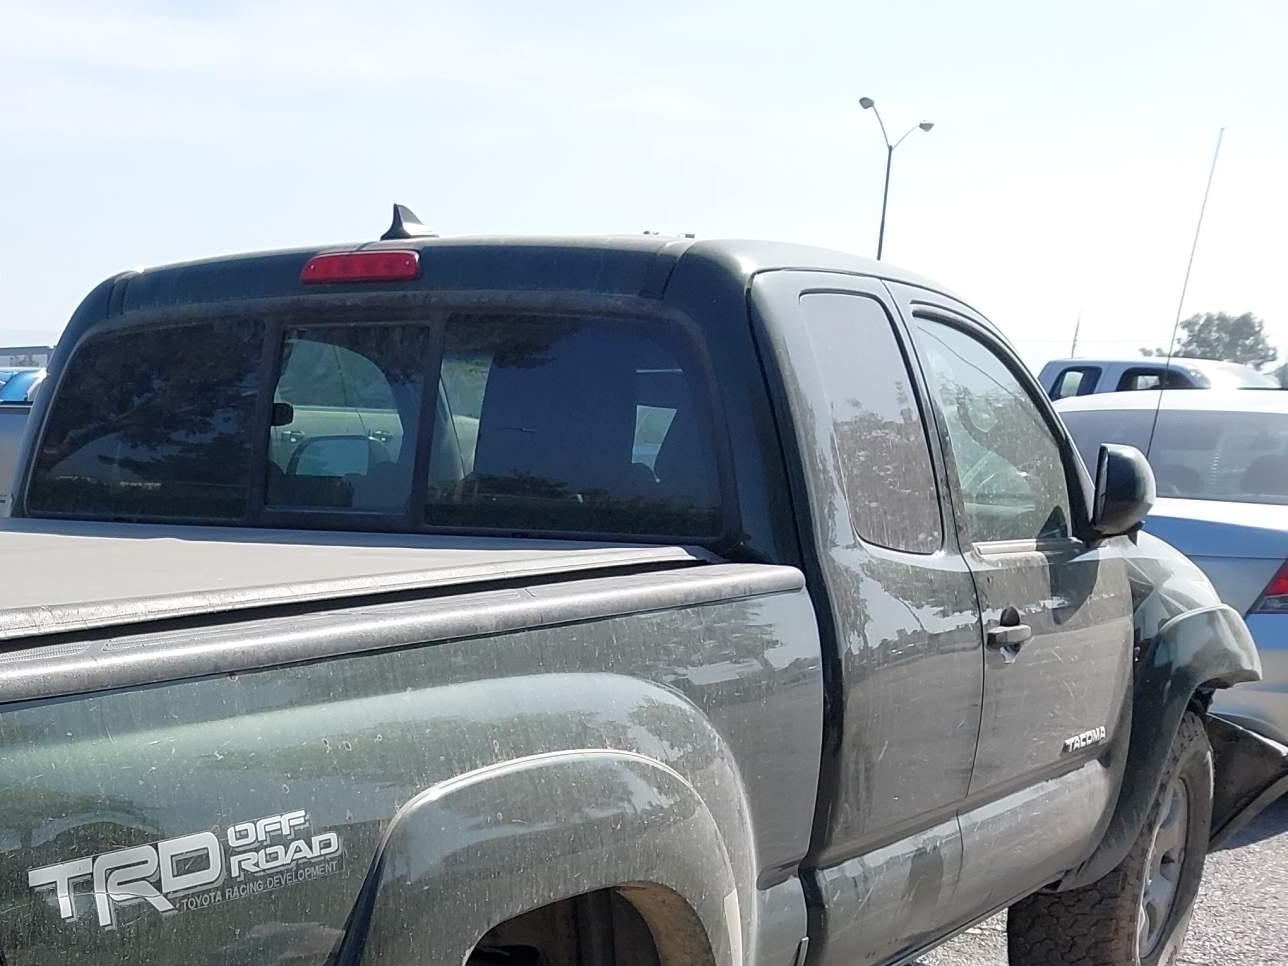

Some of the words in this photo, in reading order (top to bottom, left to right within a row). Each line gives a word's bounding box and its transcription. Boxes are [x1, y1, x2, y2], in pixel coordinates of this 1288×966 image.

[1064, 726, 1106, 752] TACOMA
[227, 810, 308, 848] OFF
[230, 832, 340, 878] ROAD
[28, 831, 223, 928] TRD
[182, 890, 223, 911] TOYOTA
[225, 879, 264, 900] RACING
[267, 860, 338, 889] DEVELOPMENT
